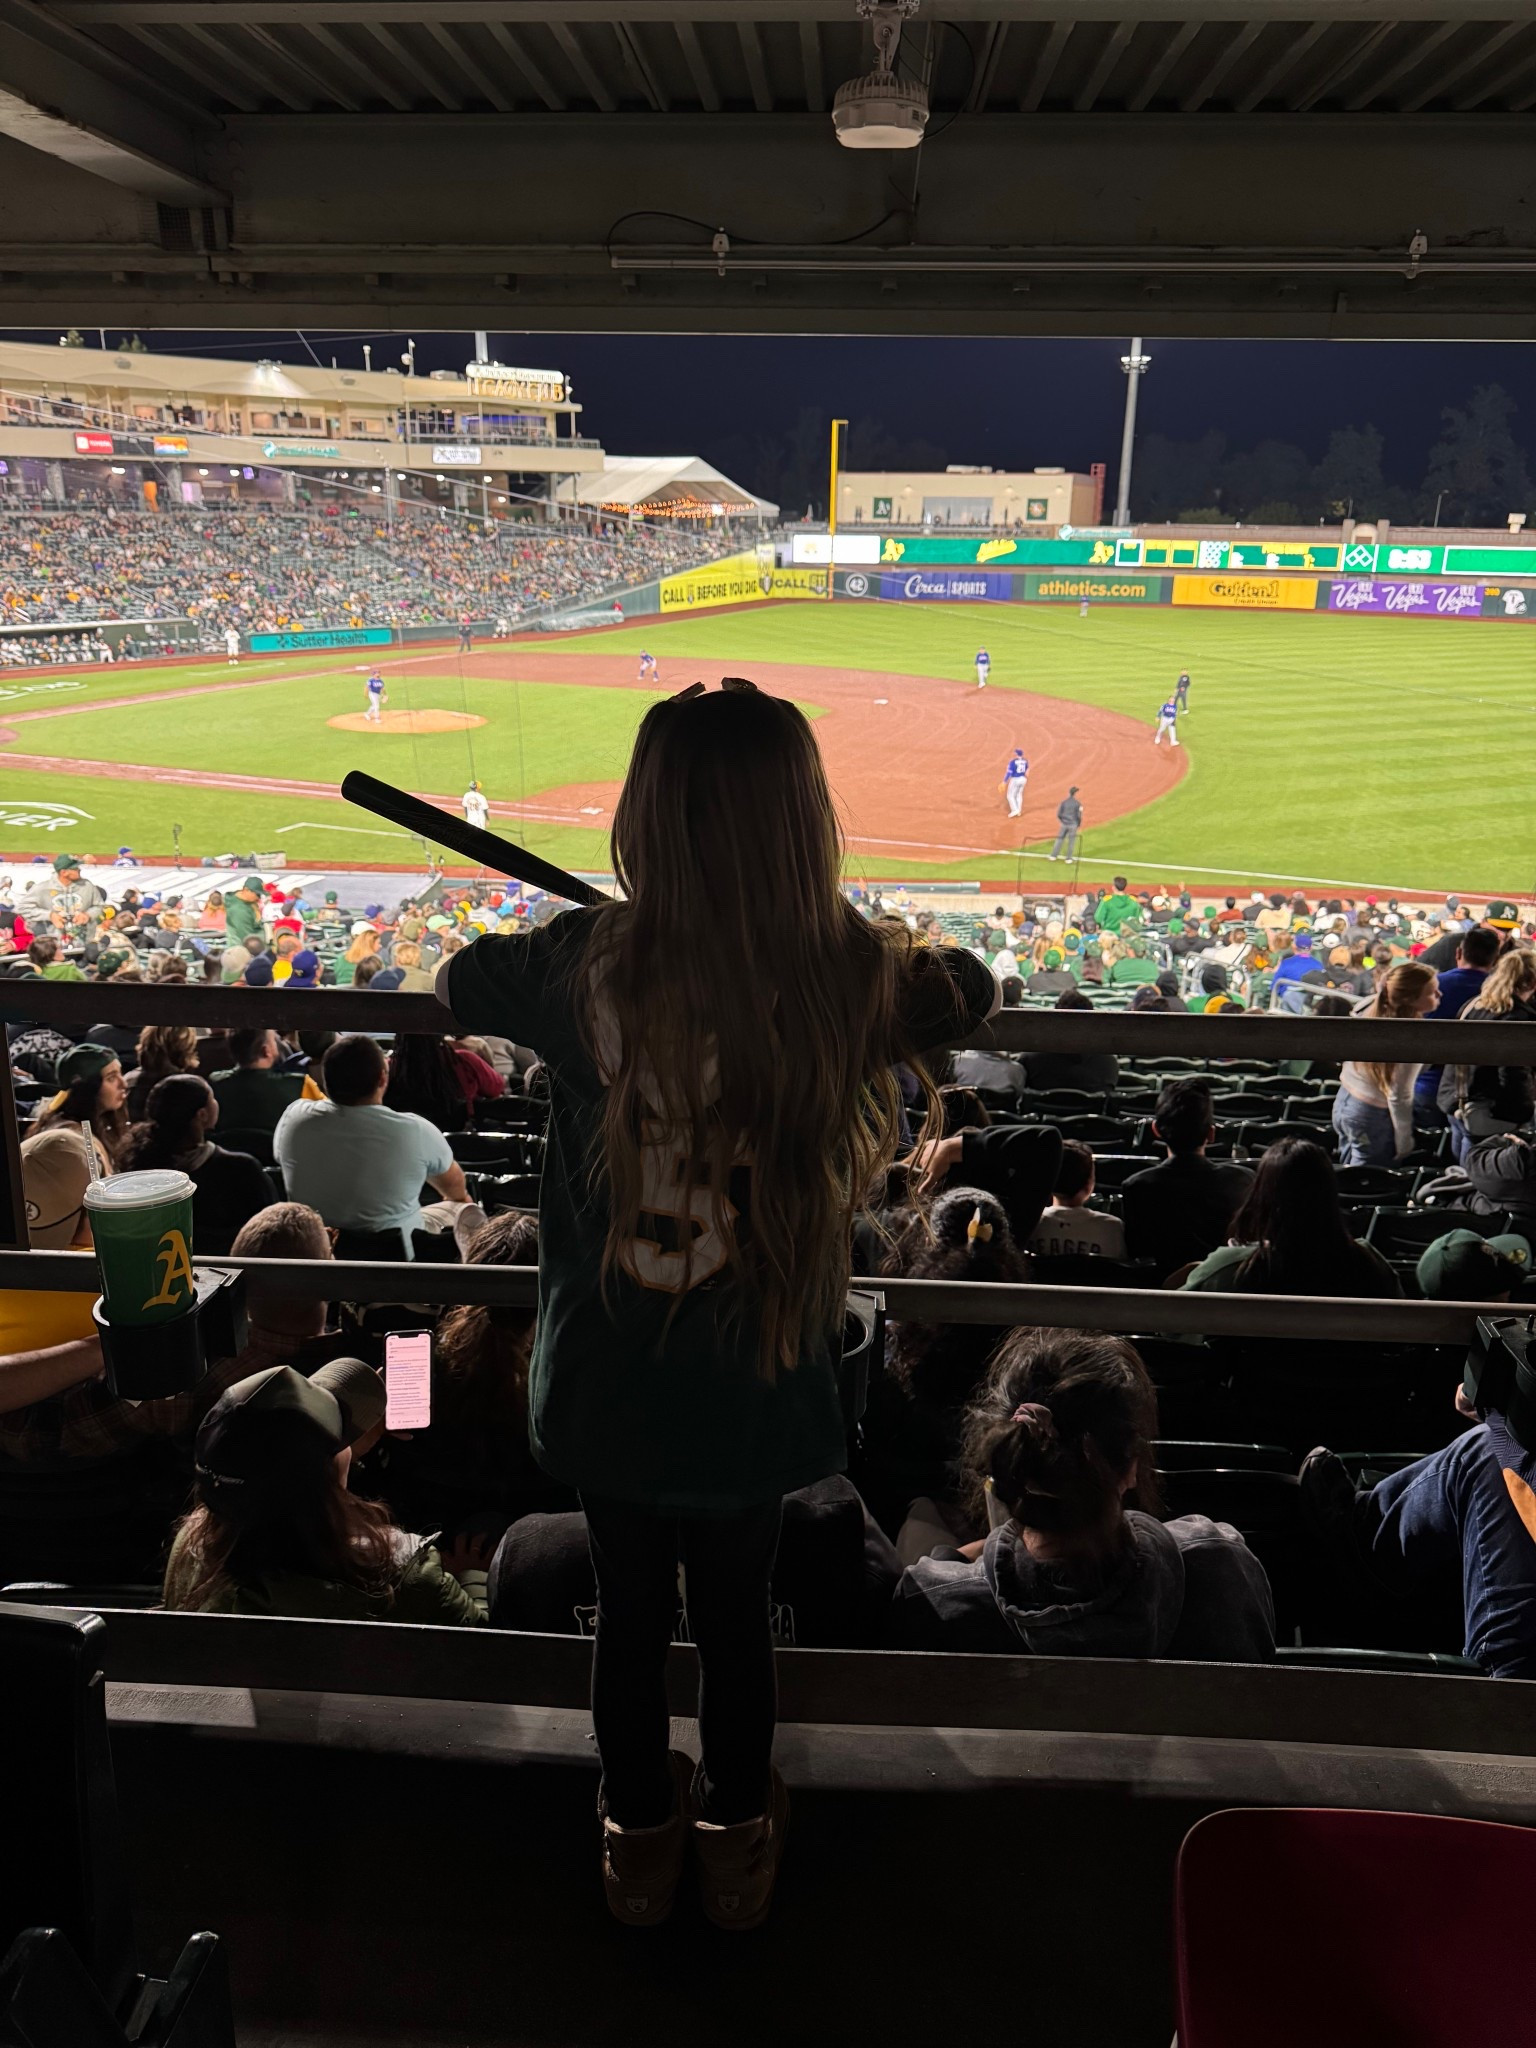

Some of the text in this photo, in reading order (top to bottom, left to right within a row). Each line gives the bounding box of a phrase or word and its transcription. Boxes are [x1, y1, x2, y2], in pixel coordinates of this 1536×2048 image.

[775, 579, 806, 589] CALL
[850, 579, 864, 591] 42
[905, 574, 987, 598] Circa SPORTS
[1039, 580, 1146, 597] athletics.com
[663, 587, 685, 605] CALL
[697, 583, 727, 600] BEFORE
[291, 631, 368, 648] Sutter Health
